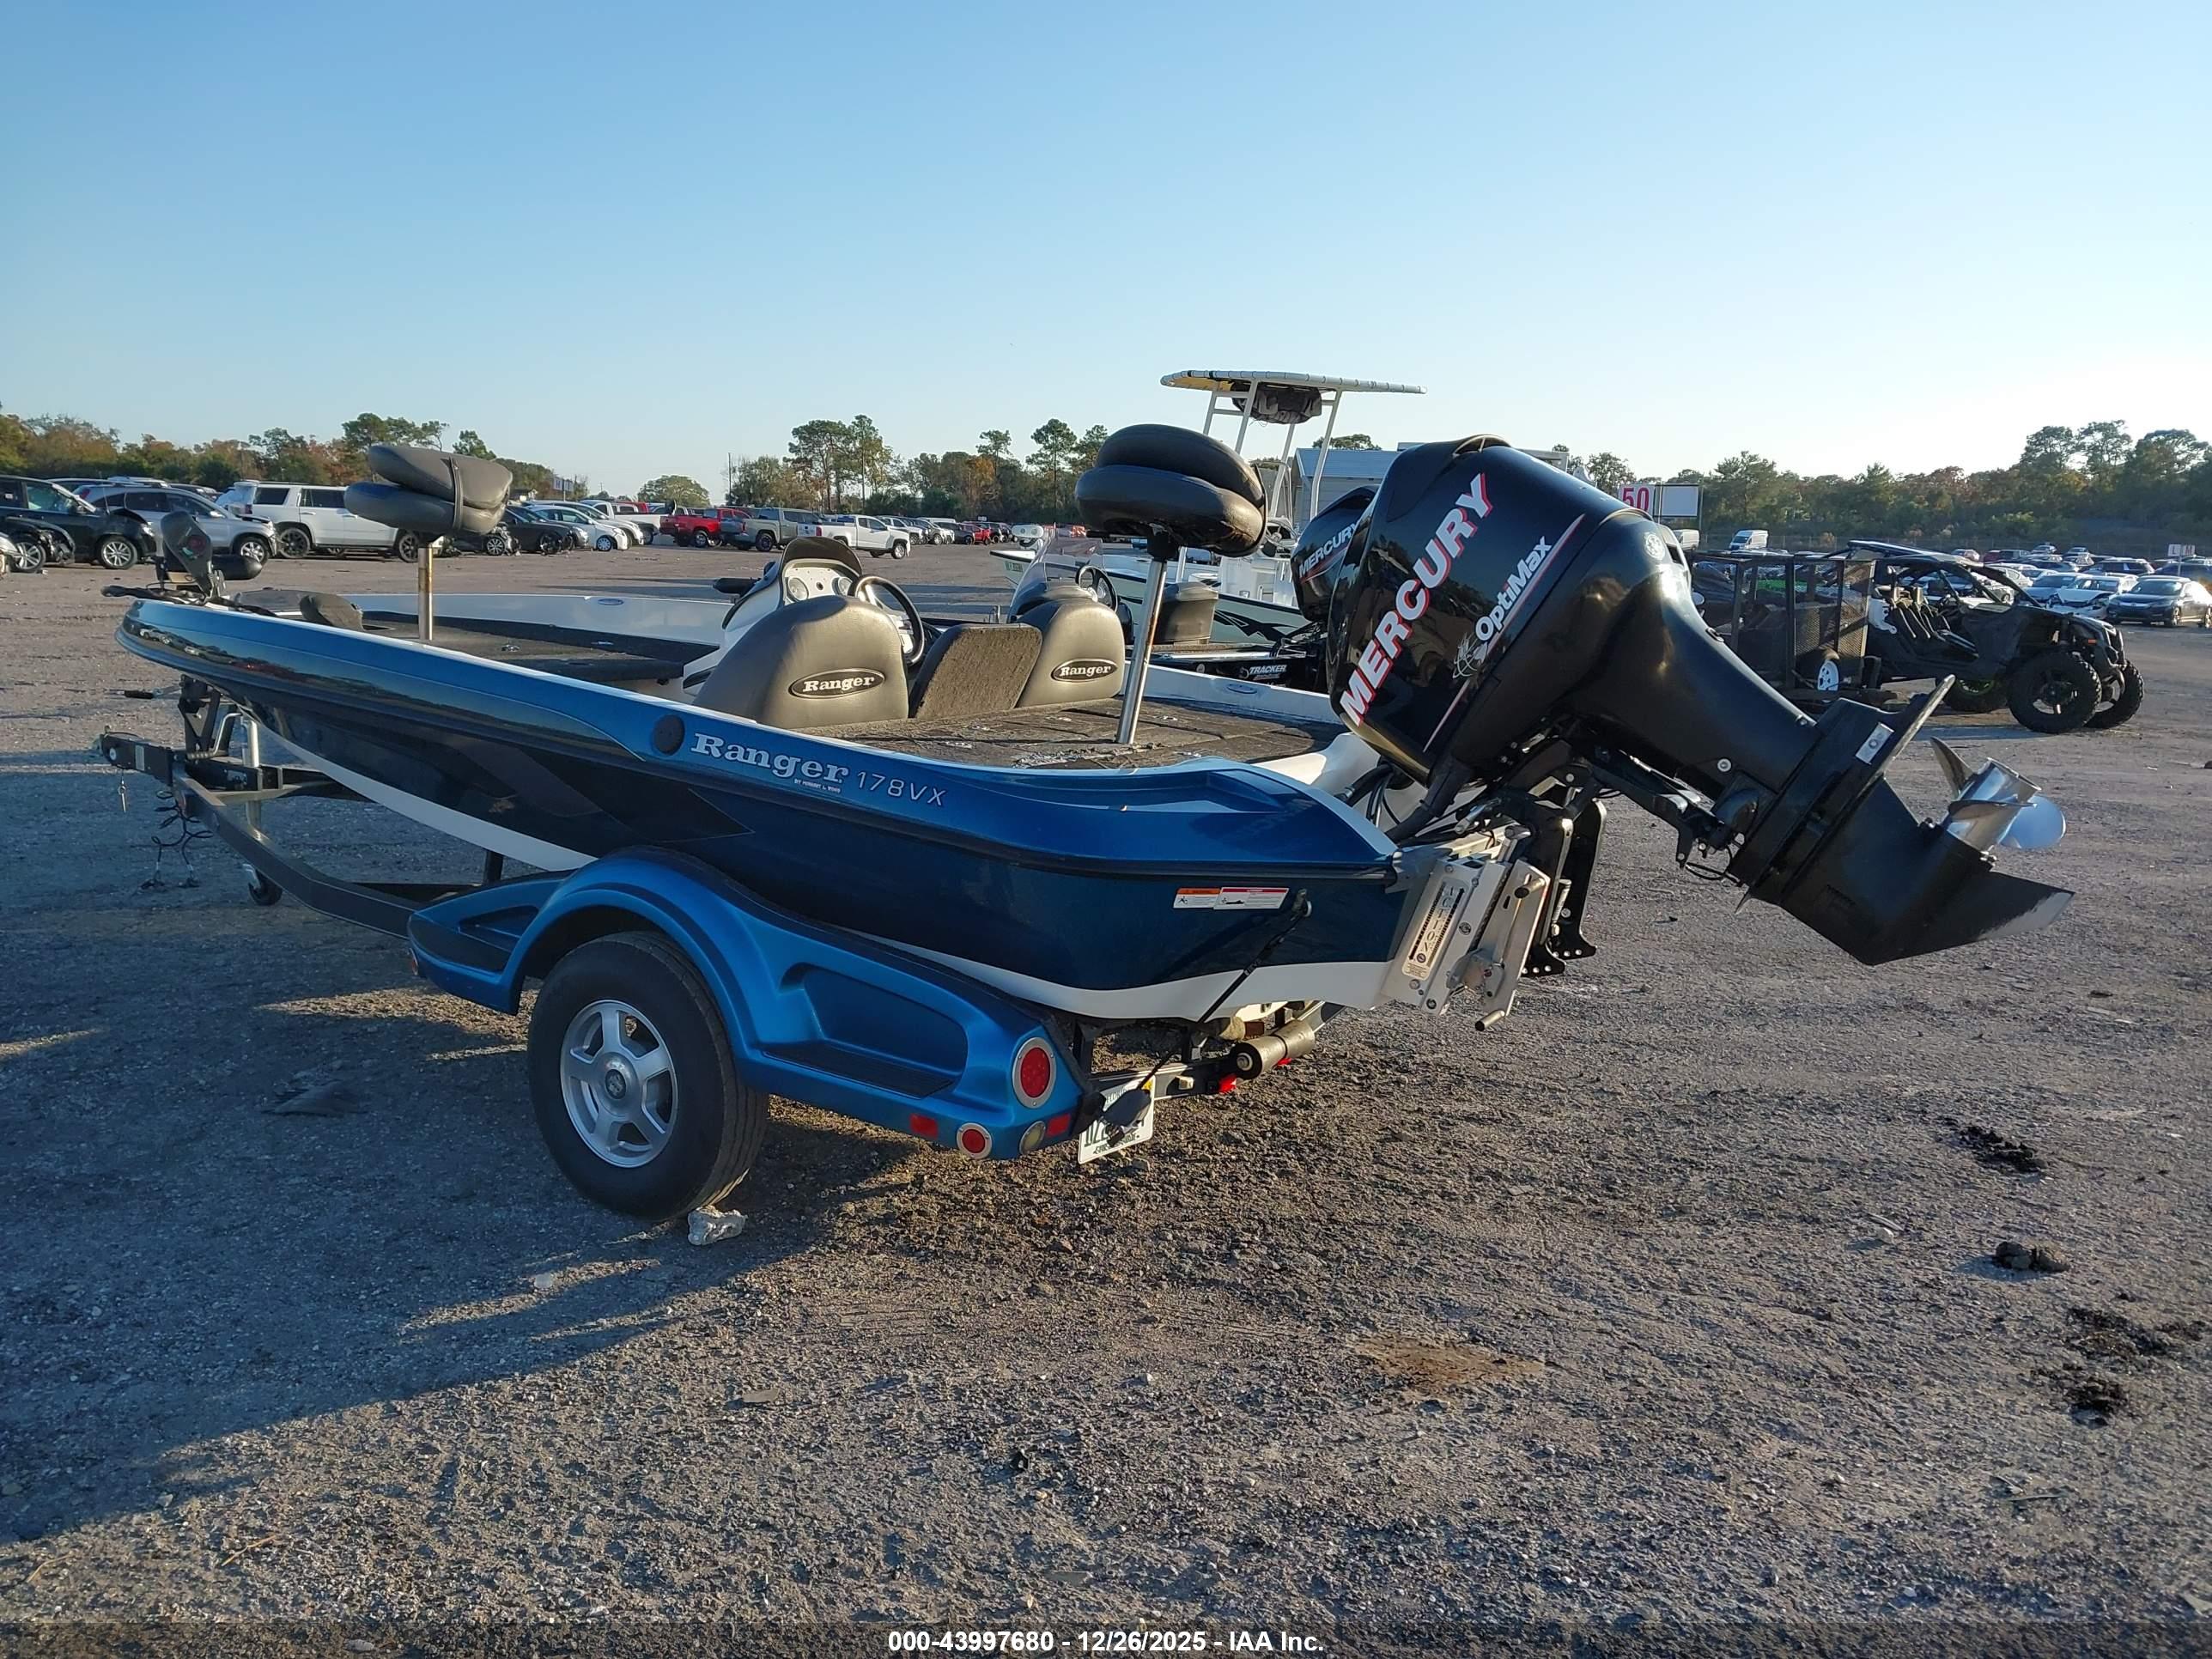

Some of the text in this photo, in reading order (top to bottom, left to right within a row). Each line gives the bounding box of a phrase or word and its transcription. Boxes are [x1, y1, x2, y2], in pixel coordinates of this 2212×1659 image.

[1622, 487, 1650, 513] 50
[1340, 473, 1493, 727] MERCURY
[1475, 536, 1552, 641] OptiMax
[1059, 665, 1112, 677] Ranger
[1249, 665, 1287, 675] TRACKER
[802, 677, 875, 692] Ranger
[690, 732, 948, 806] Ranger 178VX
